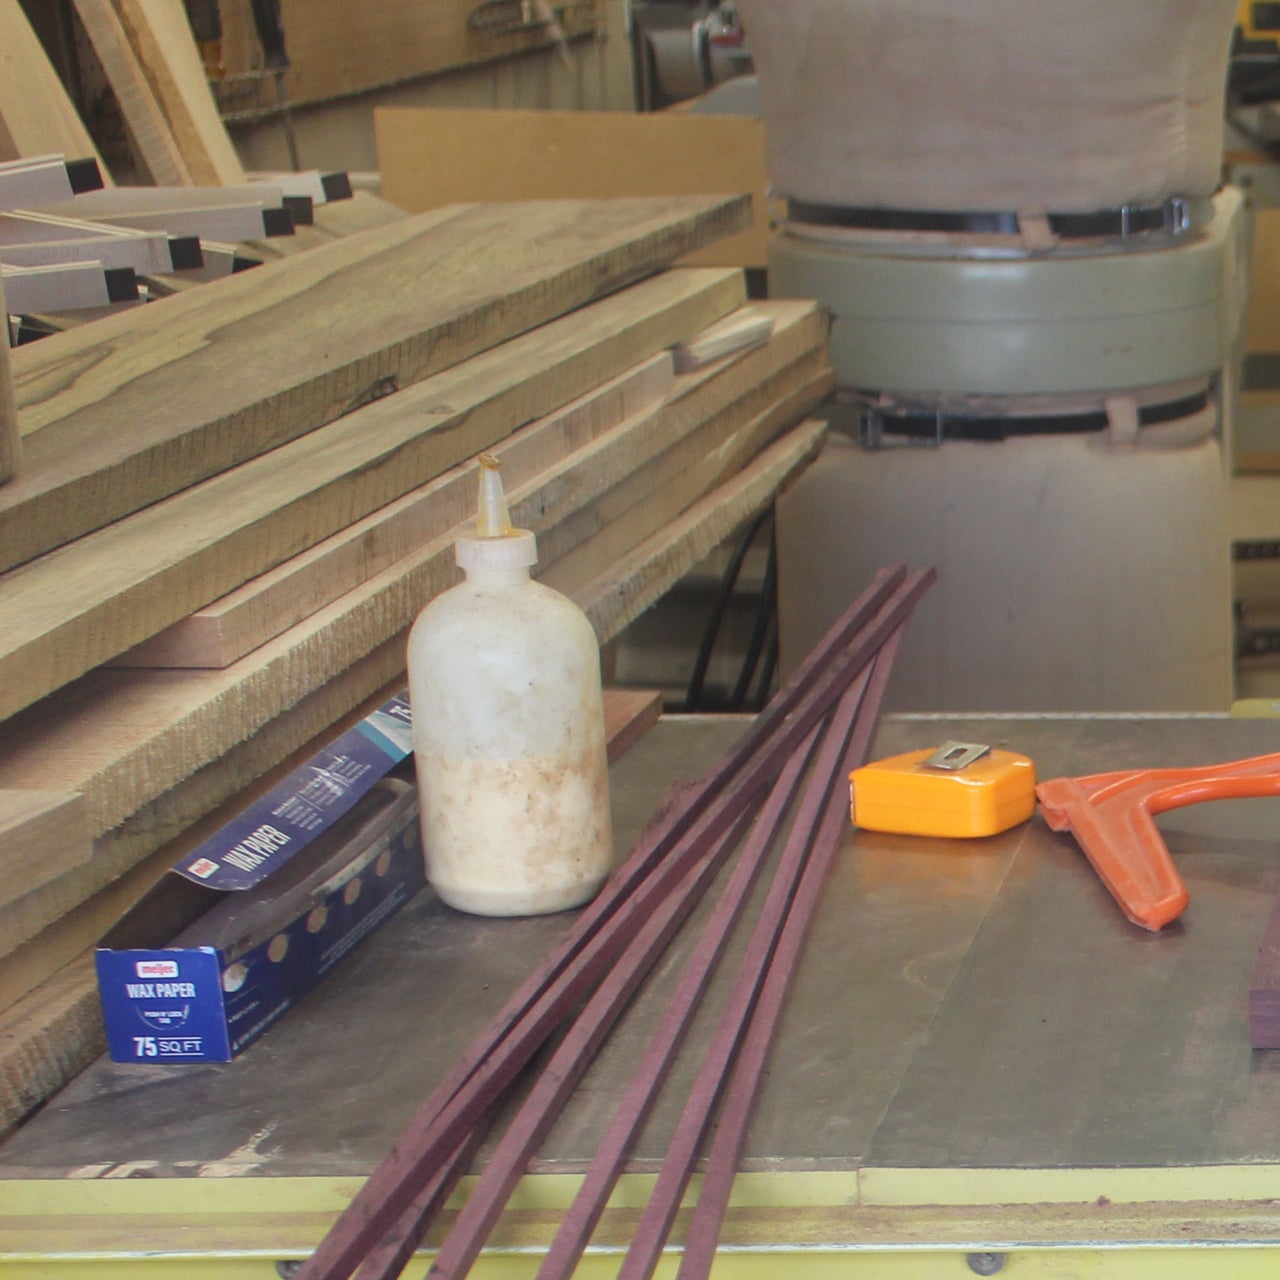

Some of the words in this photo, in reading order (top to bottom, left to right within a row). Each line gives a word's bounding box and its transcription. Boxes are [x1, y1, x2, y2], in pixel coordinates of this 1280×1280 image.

[241, 824, 292, 857] PAPER
[221, 844, 266, 873] WAX
[126, 983, 157, 998] WAX
[157, 983, 196, 998] PAPER
[133, 1036, 158, 1057] 75
[159, 1041, 182, 1053] SQ
[184, 1041, 203, 1052] FT
